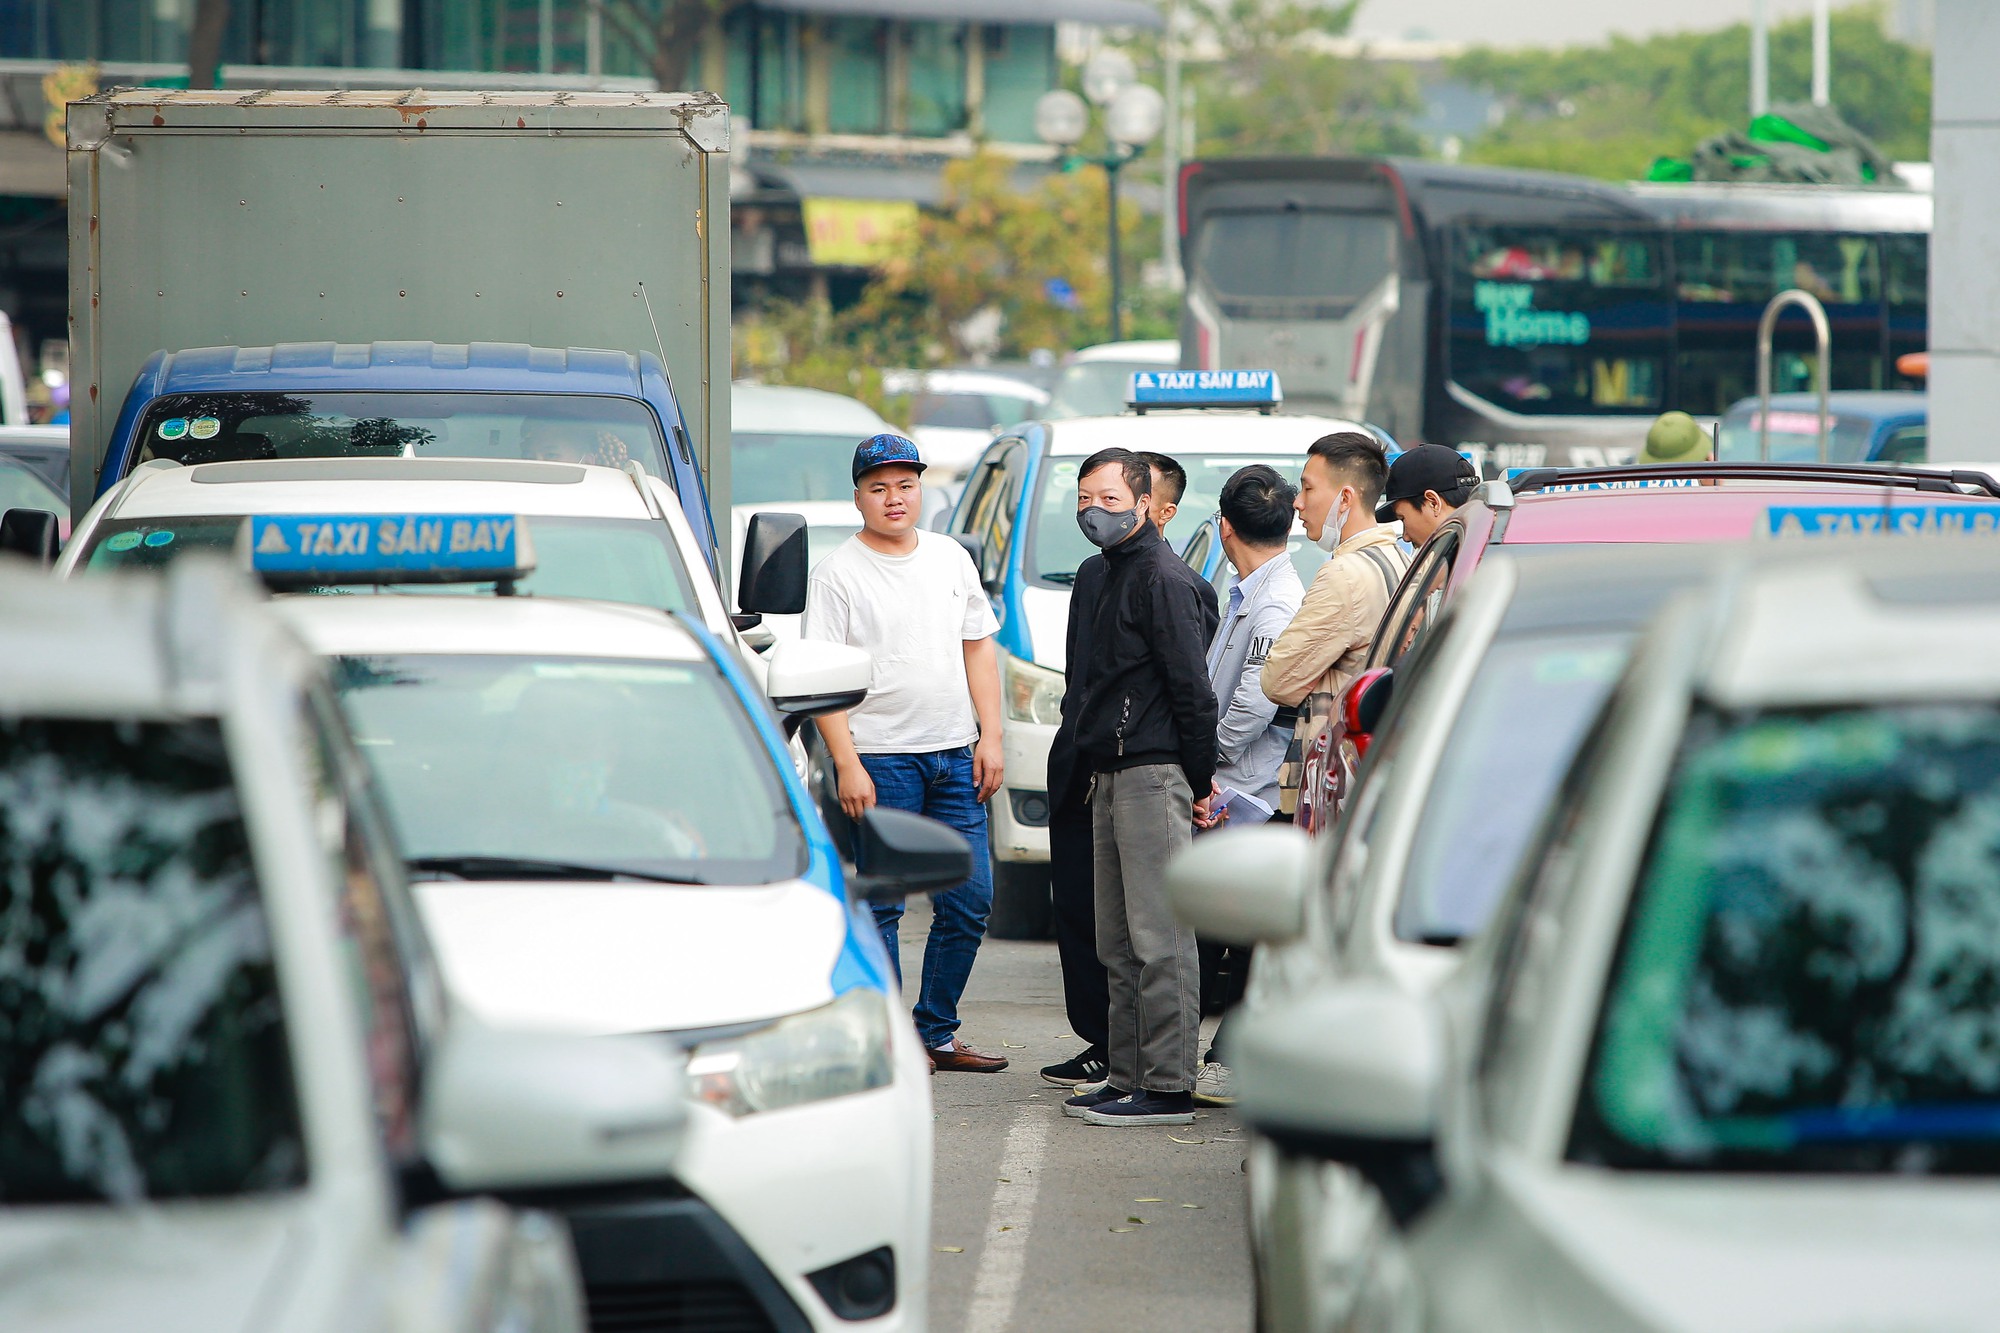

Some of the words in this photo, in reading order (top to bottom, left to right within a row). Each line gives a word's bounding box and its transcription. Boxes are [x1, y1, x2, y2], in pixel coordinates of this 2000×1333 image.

[1157, 372, 1196, 389] TAXI
[1237, 371, 1270, 389] BAY
[297, 522, 370, 555] TAXI
[450, 519, 515, 553] BAY
